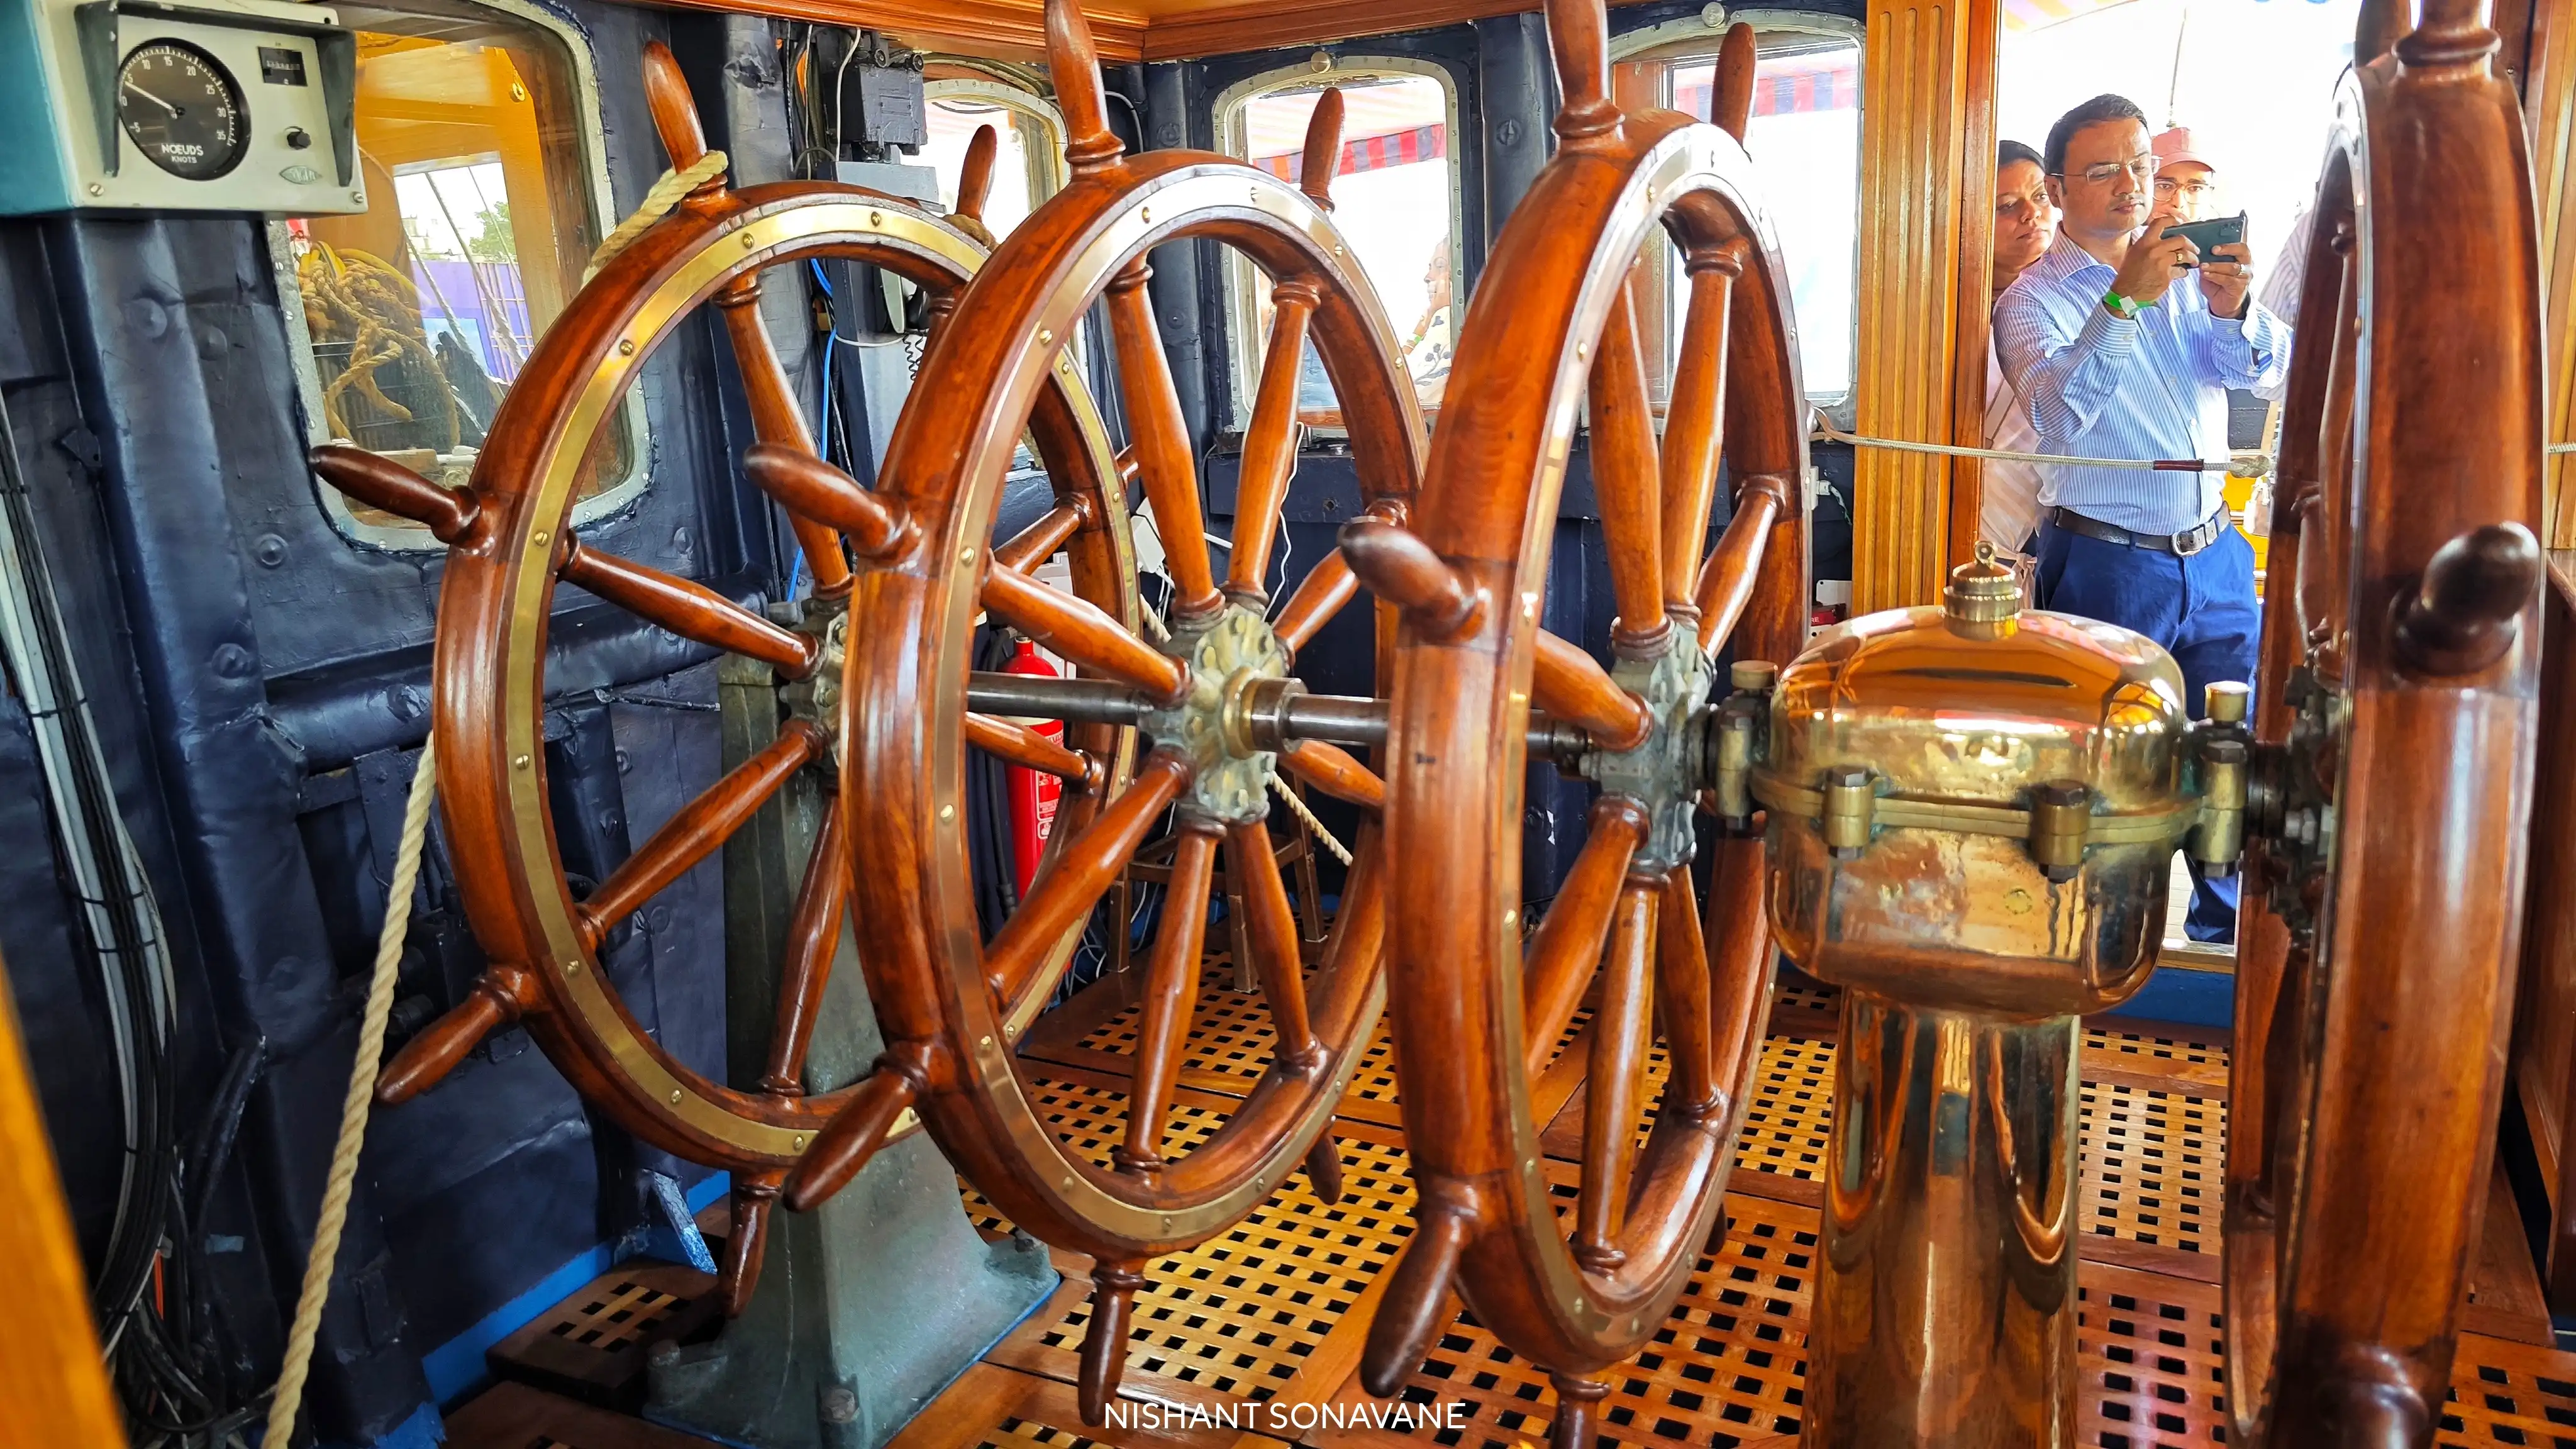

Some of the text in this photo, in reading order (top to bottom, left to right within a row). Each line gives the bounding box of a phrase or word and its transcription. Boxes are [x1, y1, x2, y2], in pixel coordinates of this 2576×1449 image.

[142, 60, 150, 70] 10
[164, 57, 172, 67] 15
[187, 66, 196, 76] 20
[127, 74, 133, 83] 5
[206, 85, 215, 95] 25
[217, 108, 226, 118] 30
[217, 130, 226, 140] 35
[171, 155, 197, 164] KNOTS
